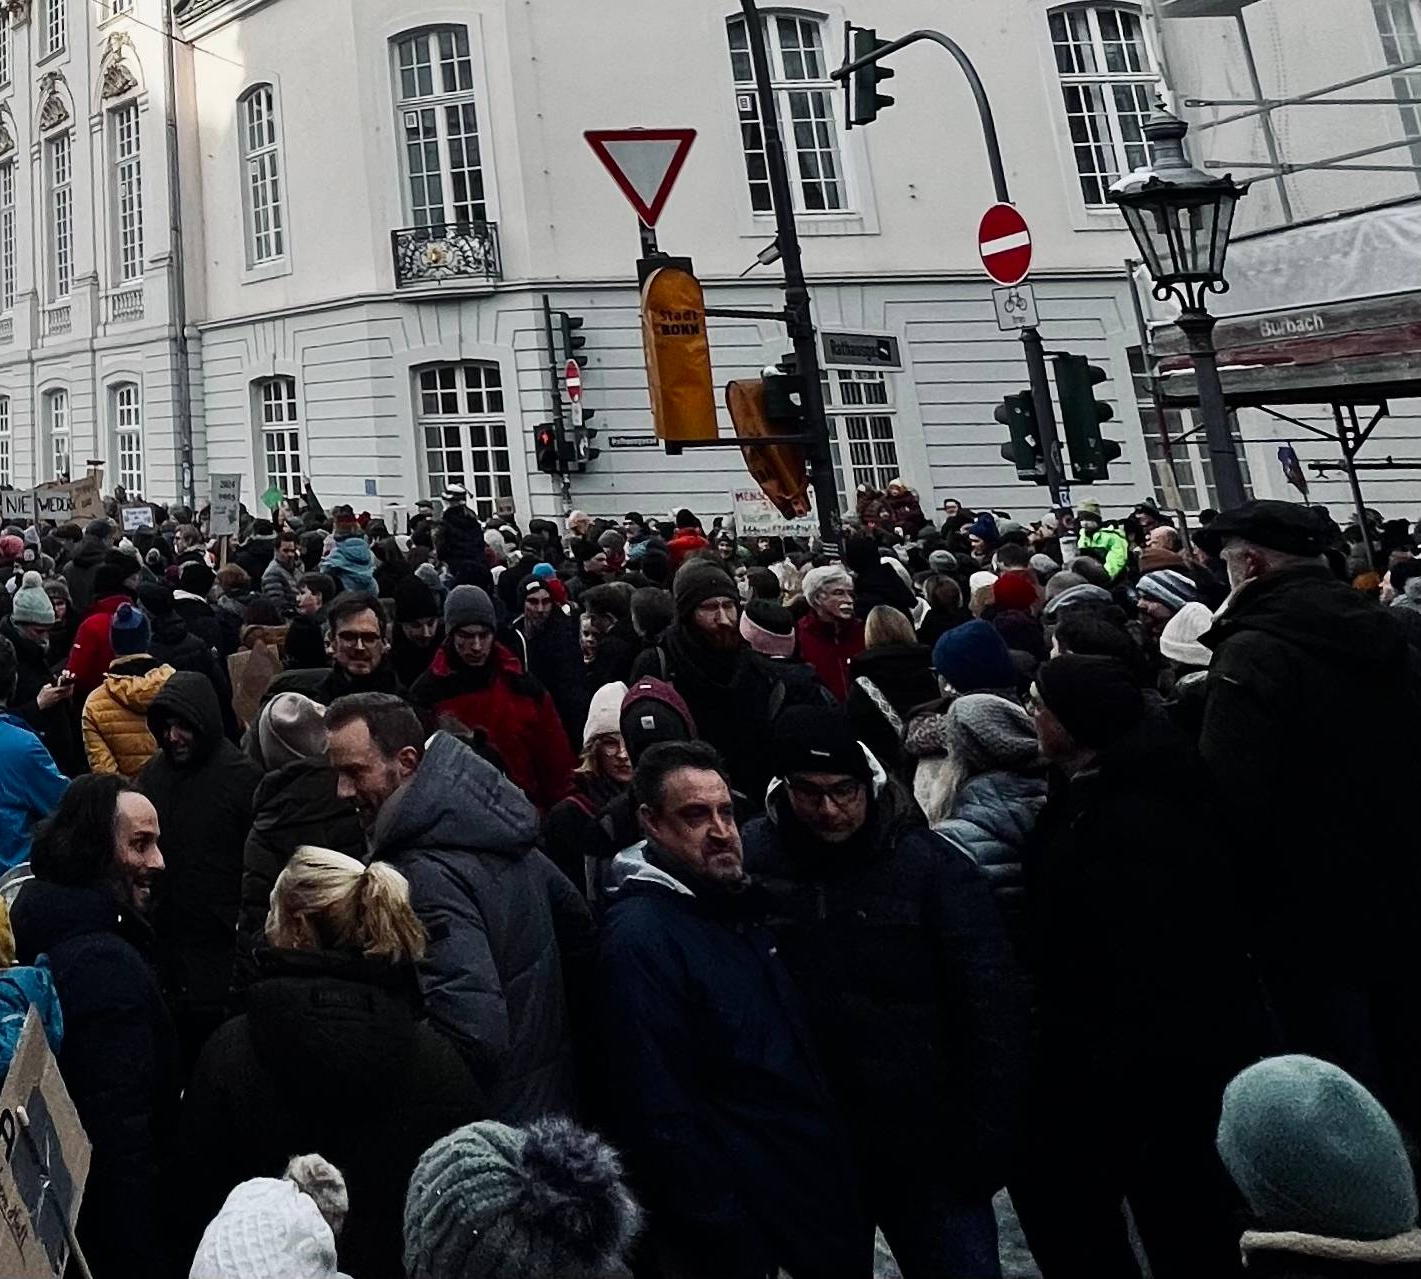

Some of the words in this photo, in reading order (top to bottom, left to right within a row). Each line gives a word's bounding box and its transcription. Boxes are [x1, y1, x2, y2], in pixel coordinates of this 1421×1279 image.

[659, 309, 700, 321] Stadt
[1259, 314, 1325, 337] Burbach
[6, 495, 32, 514] NIE
